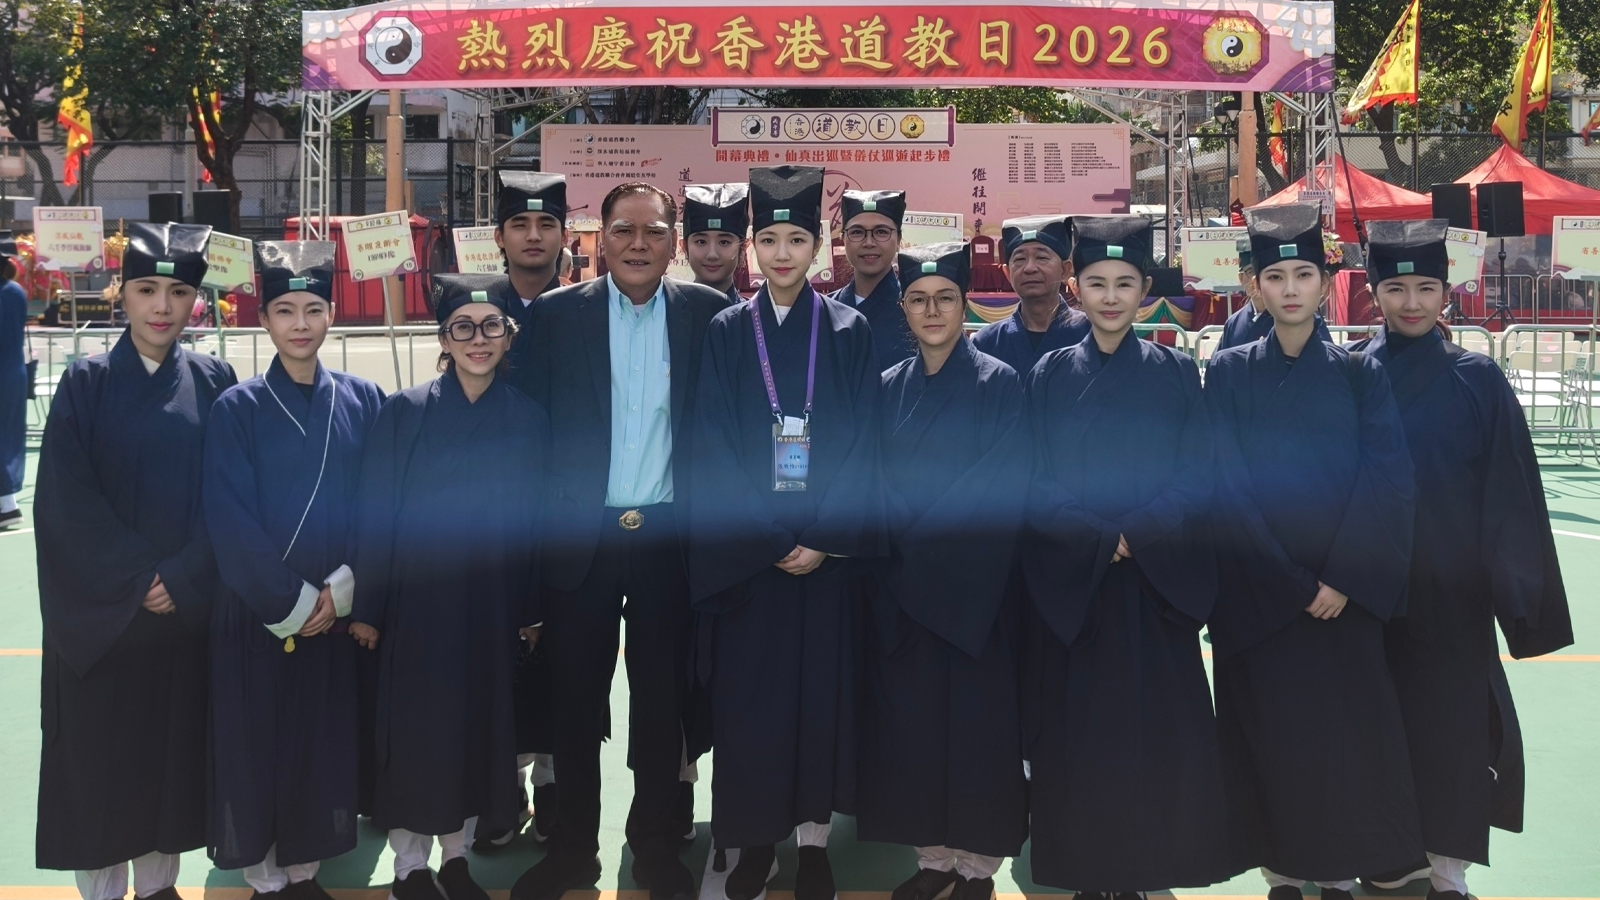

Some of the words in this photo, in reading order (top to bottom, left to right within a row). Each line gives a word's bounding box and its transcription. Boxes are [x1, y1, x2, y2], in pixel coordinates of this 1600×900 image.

[456, 14, 1169, 71] 熱烈慶祝香港道教日2026
